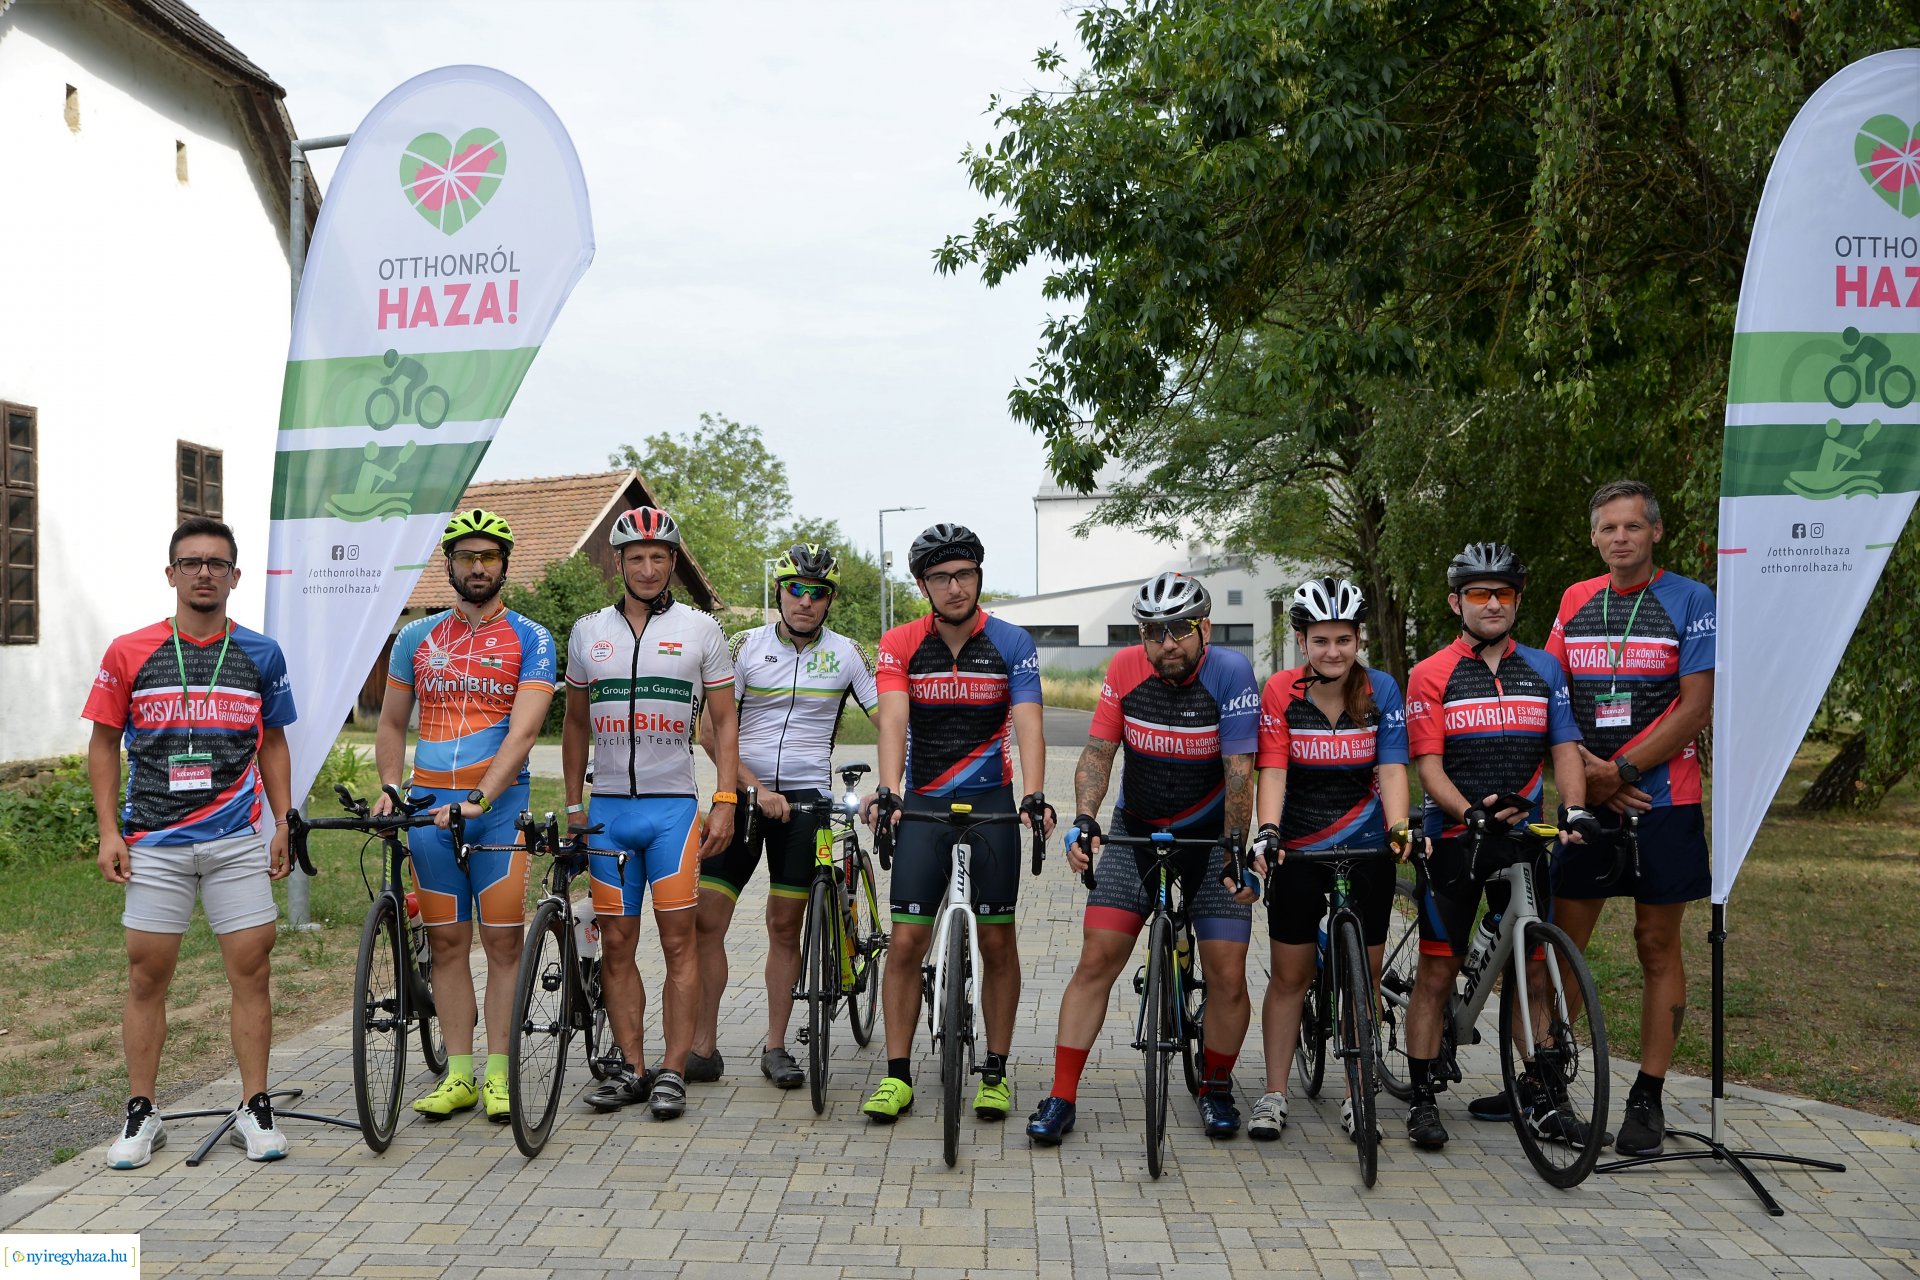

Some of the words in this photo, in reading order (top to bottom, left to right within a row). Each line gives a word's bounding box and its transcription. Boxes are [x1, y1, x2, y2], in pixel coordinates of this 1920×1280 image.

[1835, 235, 1918, 258] OTTHO
[379, 245, 520, 281] OTTHONRÓL
[378, 279, 519, 330] HAZA!
[1767, 545, 1850, 556] /otthonrolhaza
[308, 567, 382, 578] /otthonrolhaza
[1761, 562, 1853, 573] otthonrolhaza.hu
[1692, 618, 1717, 633] KK
[1626, 647, 1635, 658] ÉS
[424, 675, 515, 695] ViniBike
[653, 684, 689, 697] Garancia
[970, 681, 979, 692] ÉS
[139, 695, 218, 722] KISVÁRDA
[218, 699, 228, 710] ÉS
[1228, 693, 1259, 711] KKB
[1517, 705, 1526, 716] ÉS
[594, 713, 685, 734] ViniBike
[1445, 705, 1516, 731] KISVÁRDA
[648, 735, 683, 746] Team
[1186, 737, 1195, 748] ÉS
[1351, 739, 1360, 749] ÉS
[1522, 866, 1535, 910] GIANT
